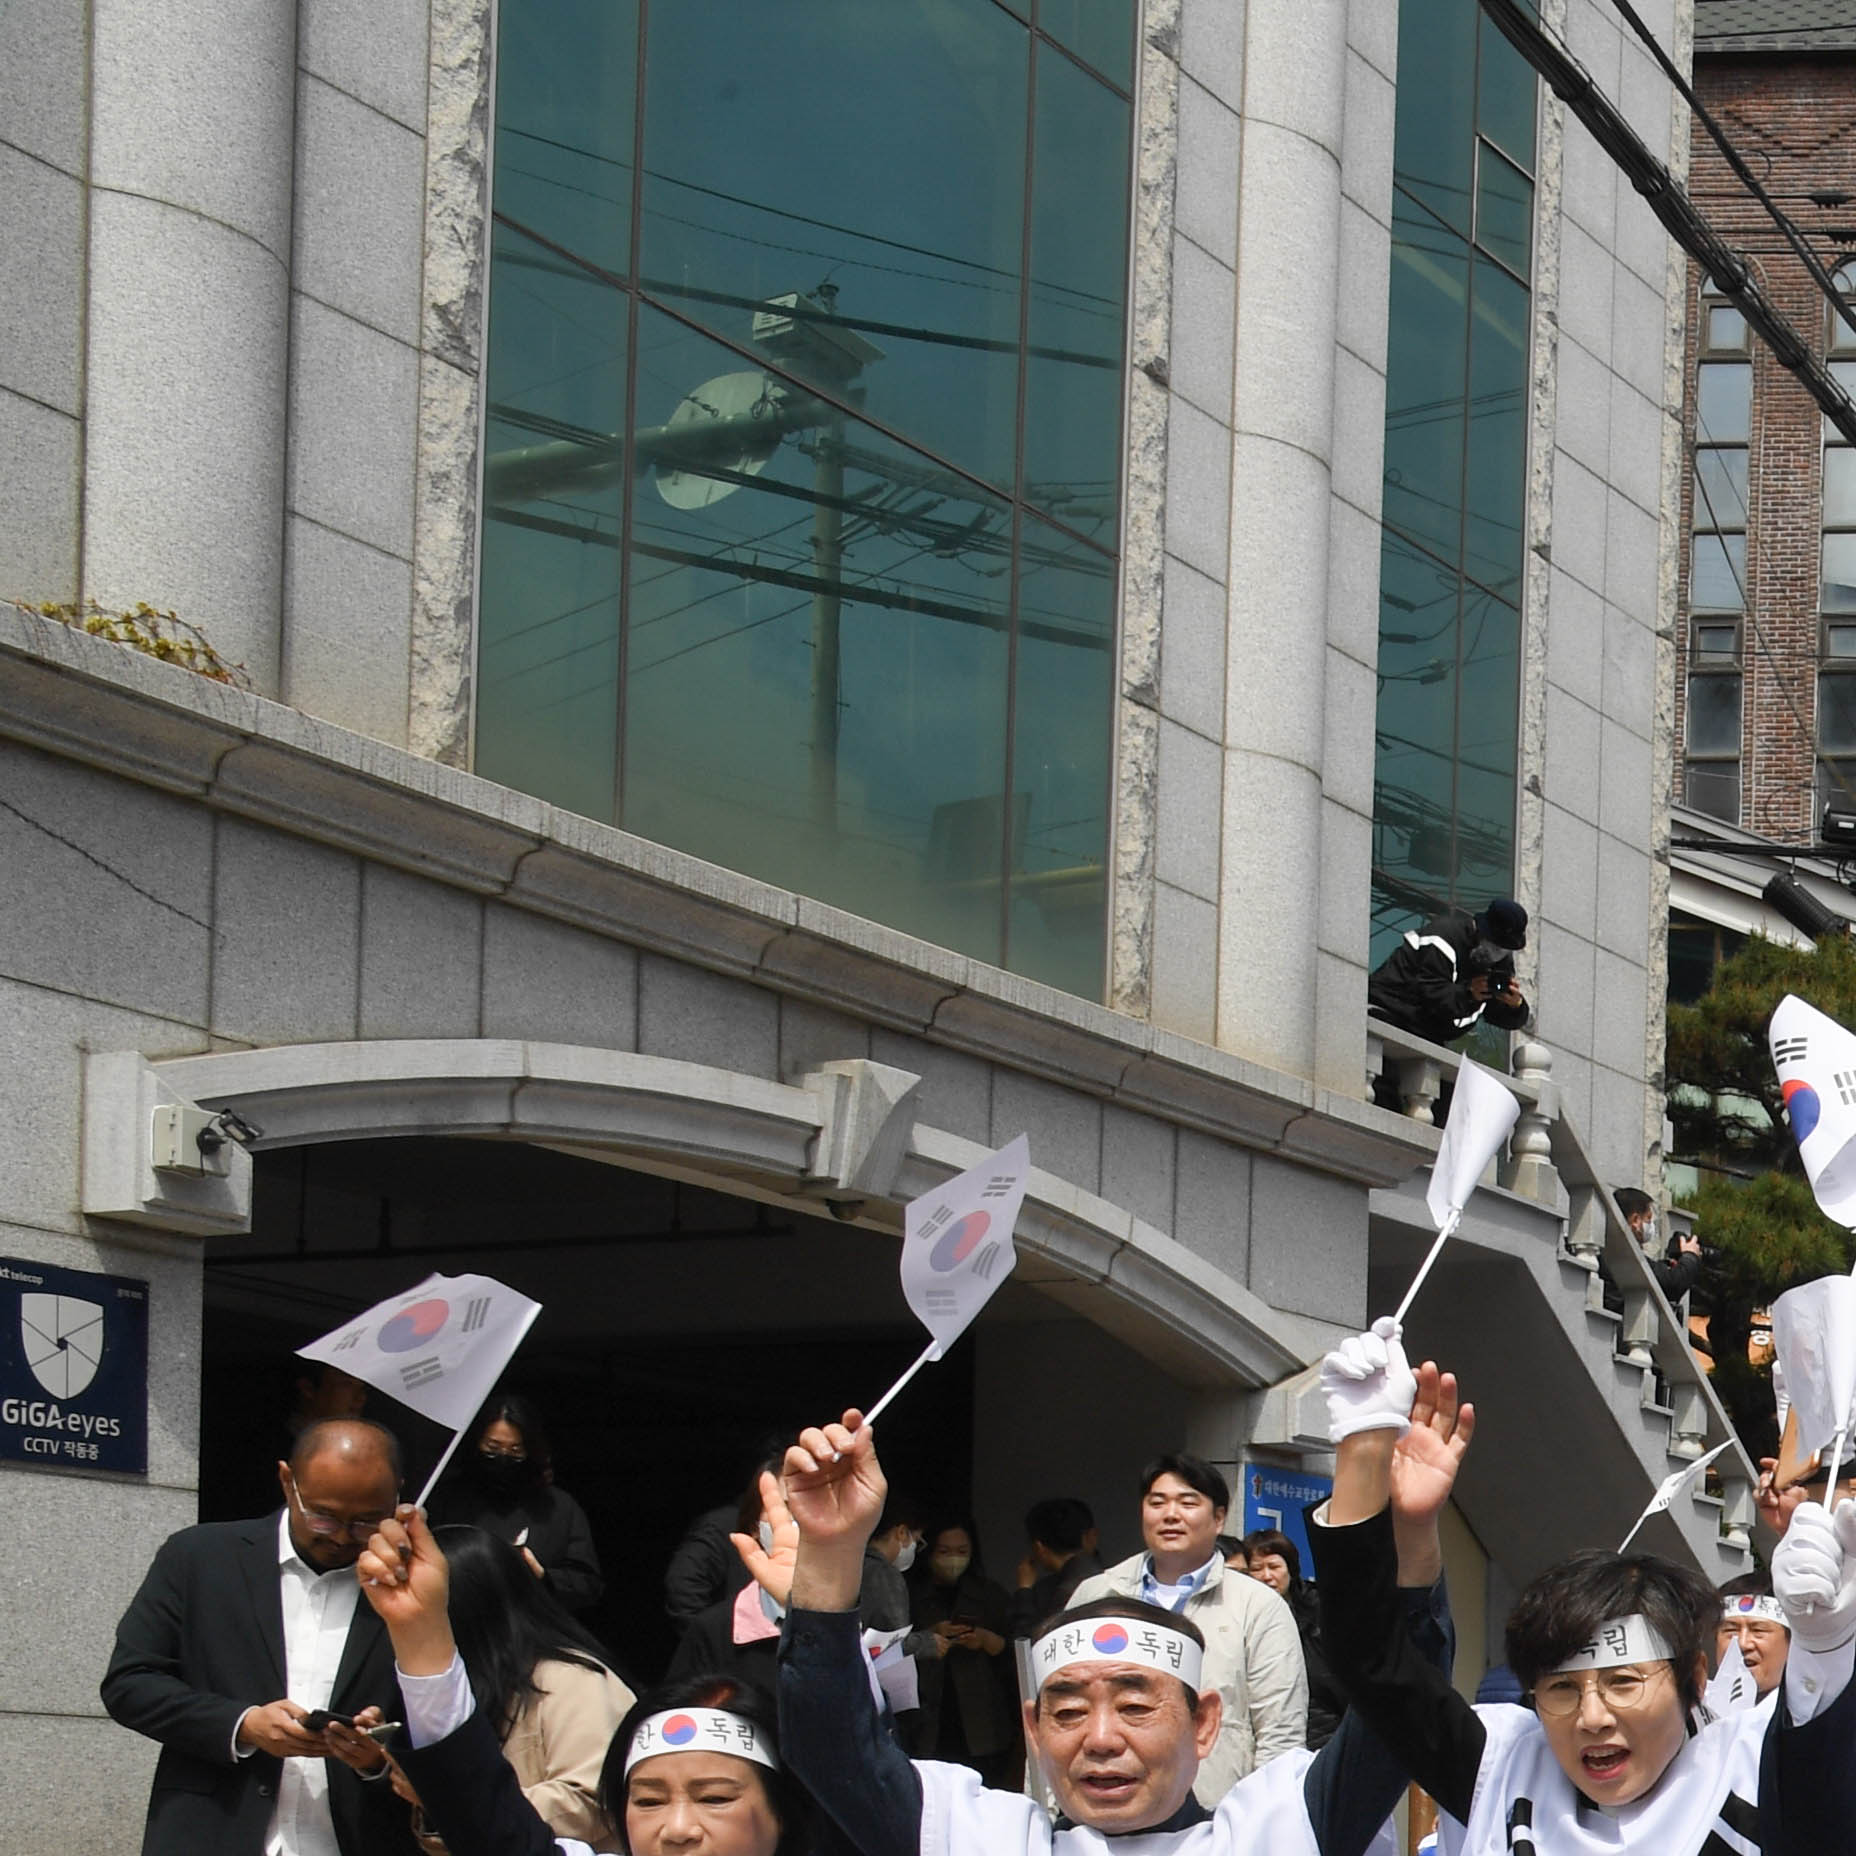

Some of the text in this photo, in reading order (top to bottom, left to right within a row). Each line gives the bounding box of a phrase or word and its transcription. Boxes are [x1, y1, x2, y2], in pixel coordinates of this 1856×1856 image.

[2, 1398, 121, 1439] GiGA eyes
[23, 1436, 100, 1461] CCTV 작동중
[1042, 1628, 1184, 1670] 대한 독립
[704, 1716, 756, 1752] 독립
